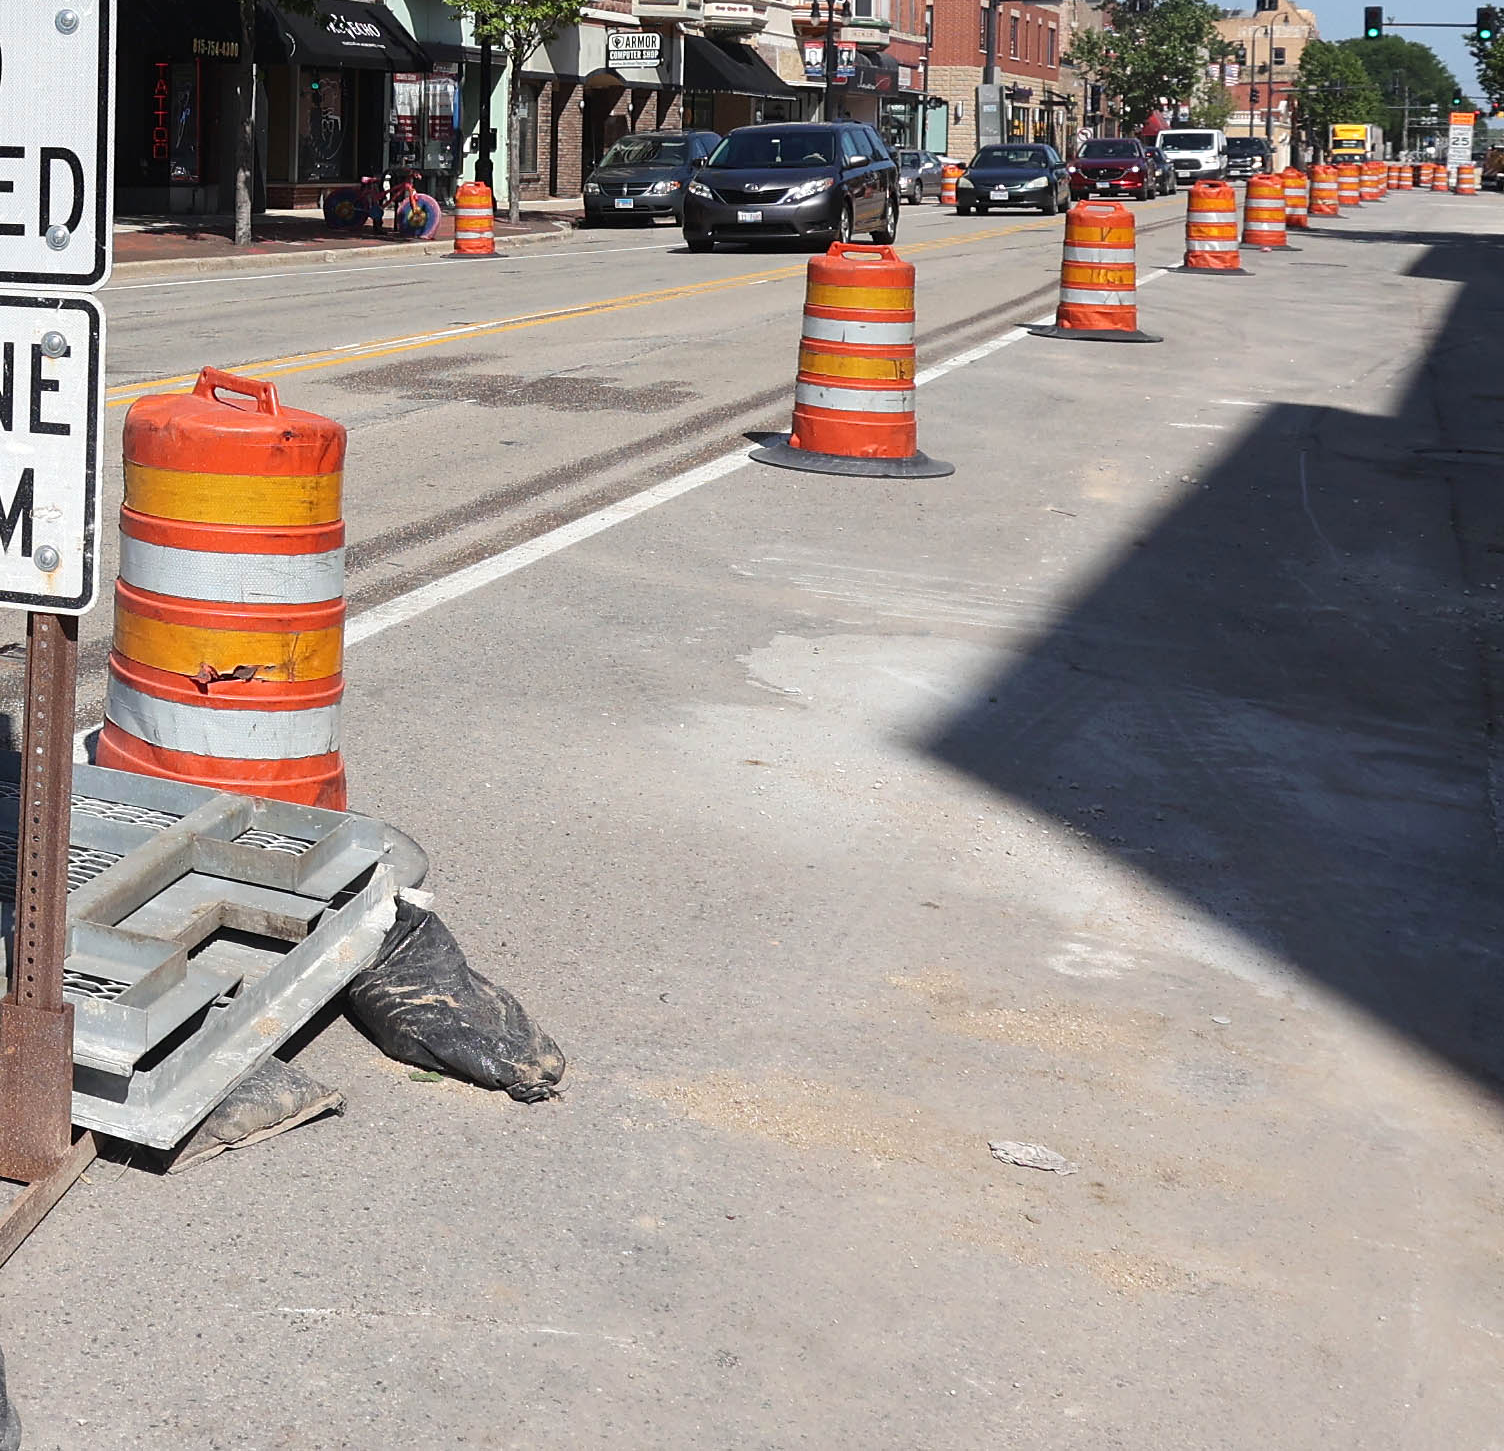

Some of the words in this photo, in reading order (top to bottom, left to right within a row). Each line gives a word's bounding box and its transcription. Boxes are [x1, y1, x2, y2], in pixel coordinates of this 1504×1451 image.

[624, 35, 657, 49] ARMOR
[609, 50, 641, 60] COMPUTER
[642, 49, 659, 59] SHOP
[152, 62, 169, 159] TATTOO
[1451, 136, 1470, 146] 25
